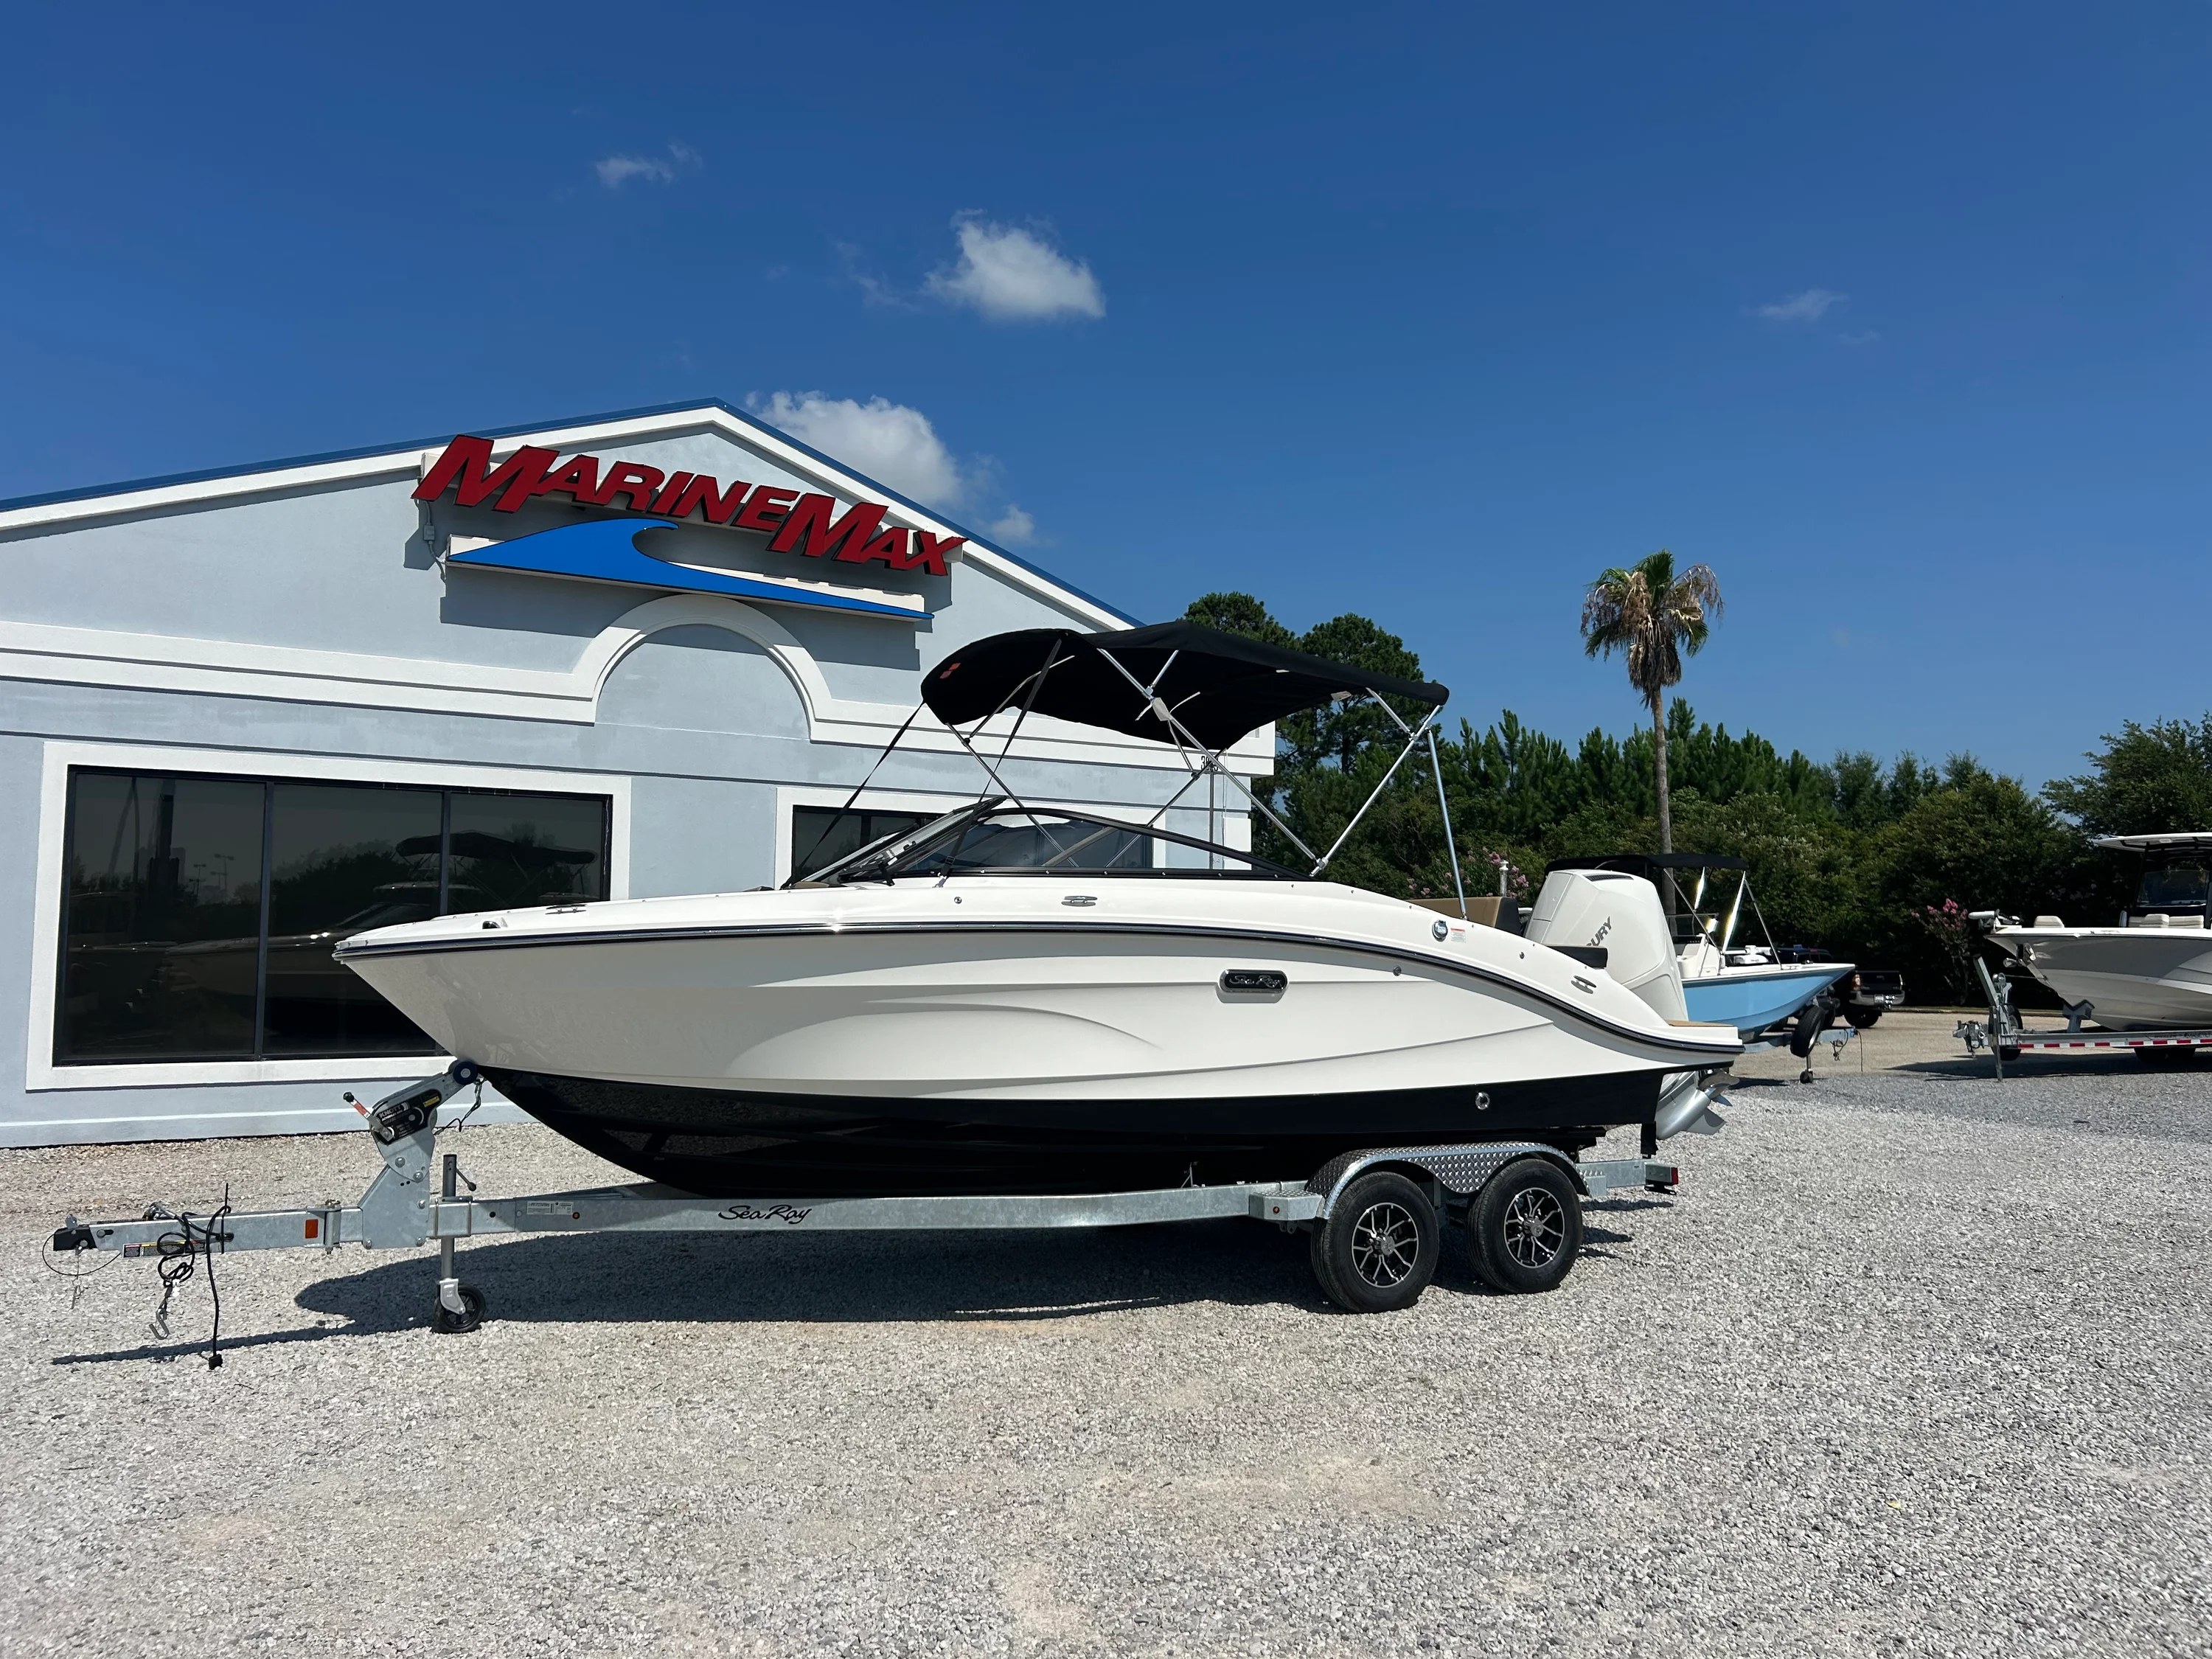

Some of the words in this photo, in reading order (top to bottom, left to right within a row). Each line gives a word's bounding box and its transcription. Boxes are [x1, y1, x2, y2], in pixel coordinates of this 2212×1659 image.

[411, 434, 967, 577] MARINEMAX
[1586, 915, 1612, 947] URY
[717, 1205, 767, 1220] Sea
[764, 1204, 813, 1225] Ray
